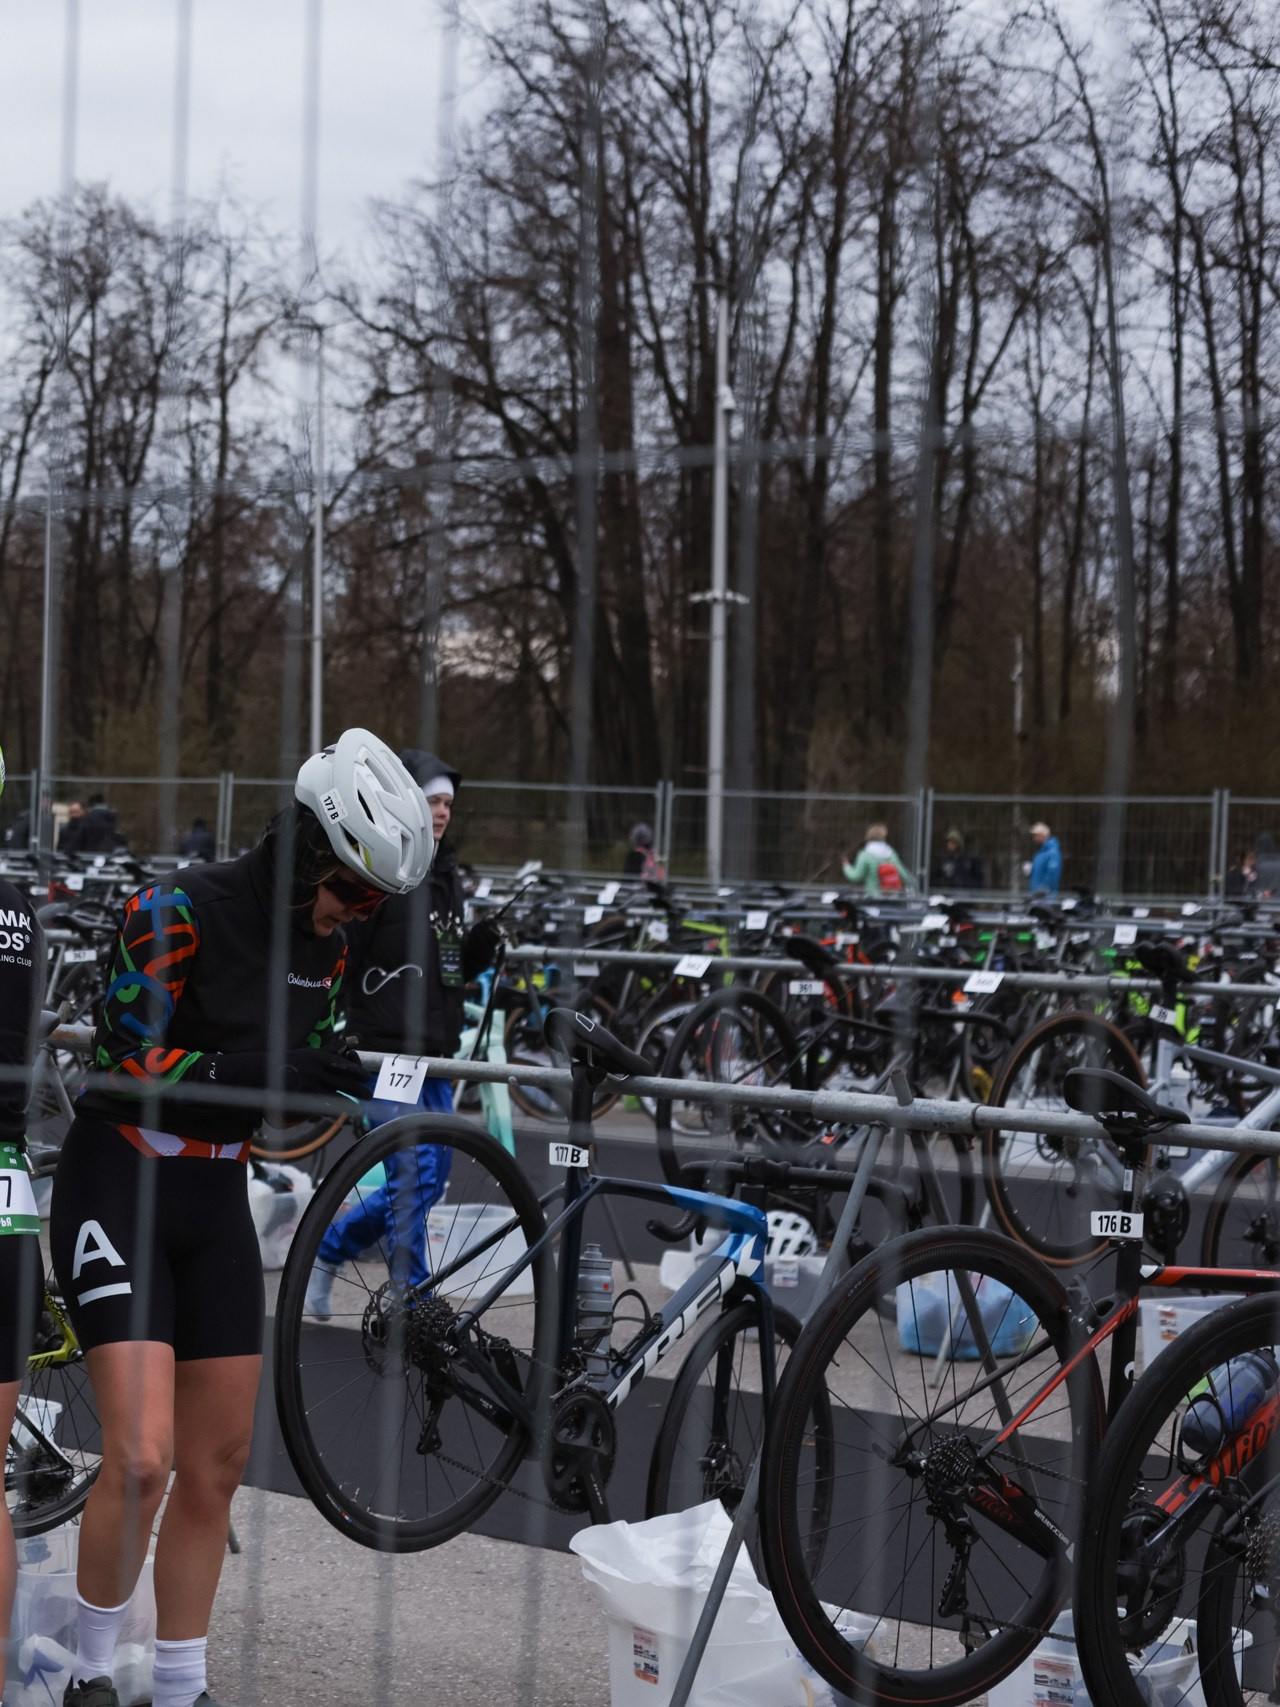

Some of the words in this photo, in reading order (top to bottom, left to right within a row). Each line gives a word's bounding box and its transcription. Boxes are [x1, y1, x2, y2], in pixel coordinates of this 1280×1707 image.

[323, 795, 335, 812] 177
[330, 811, 339, 820] B
[16, 956, 33, 968] CLUB
[389, 1072, 413, 1089] 177
[555, 1145, 569, 1163] 177
[570, 1147, 581, 1164] B
[1097, 1214, 1117, 1233] 176
[1120, 1215, 1132, 1234] B
